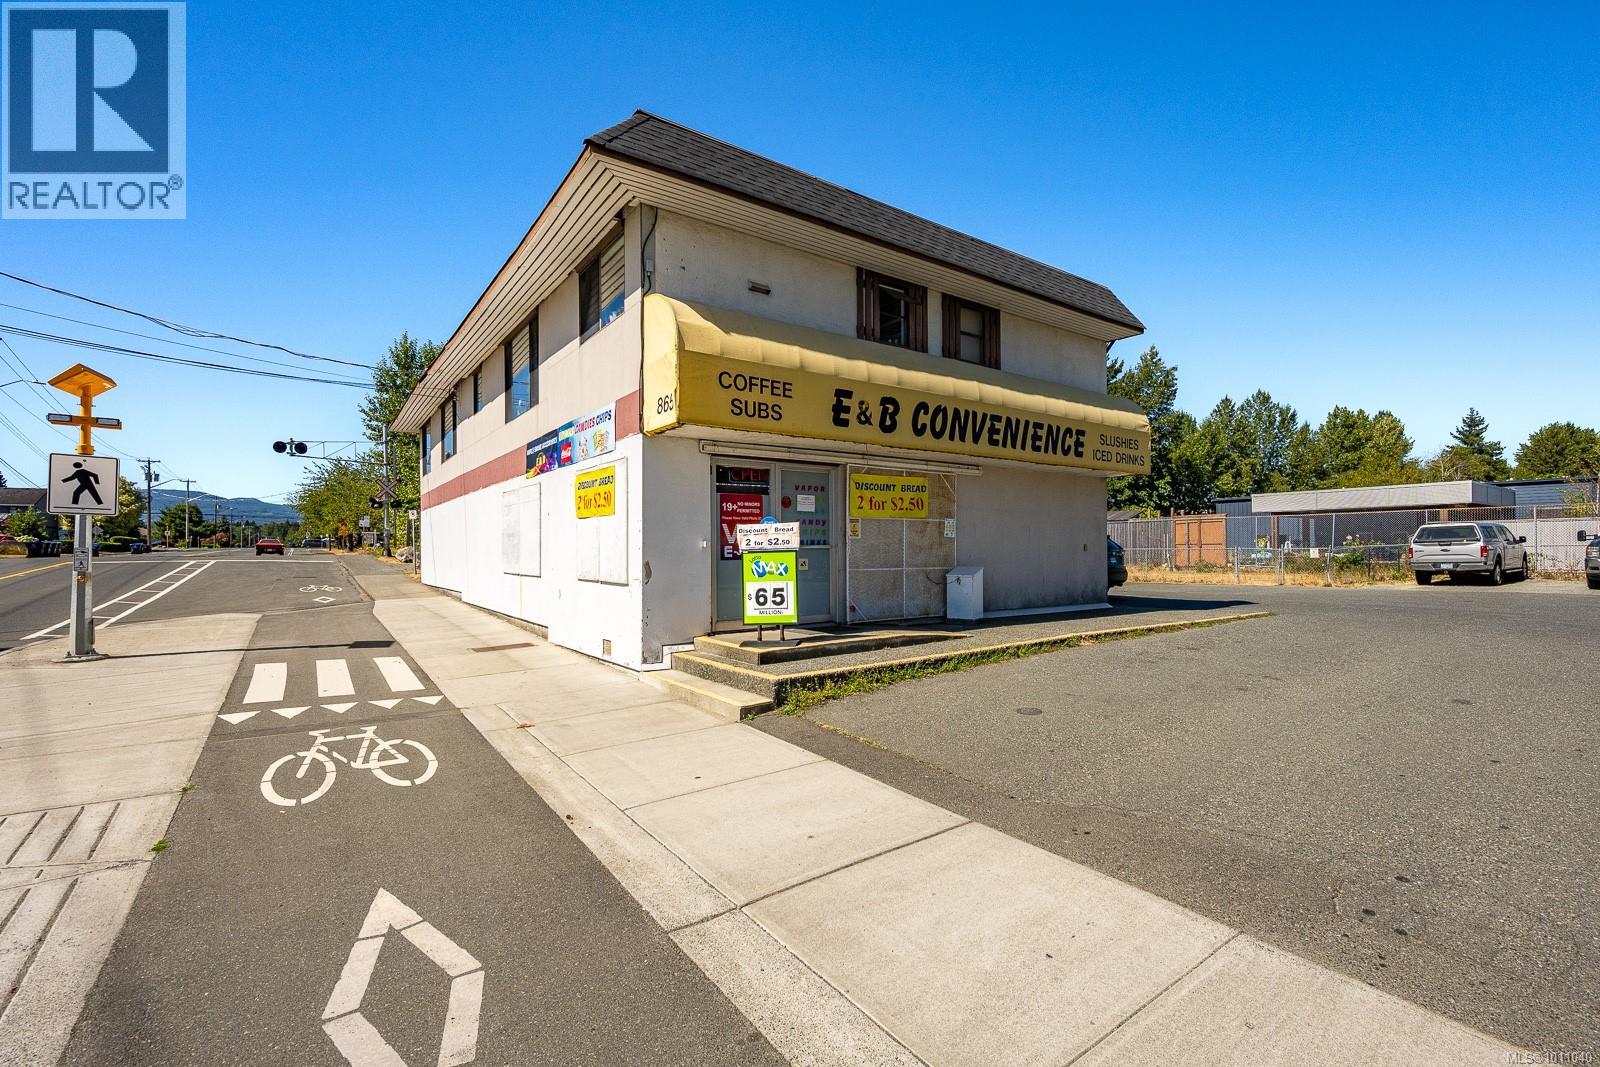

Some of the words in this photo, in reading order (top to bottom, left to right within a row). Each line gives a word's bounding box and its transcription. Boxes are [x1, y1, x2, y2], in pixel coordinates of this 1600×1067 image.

[718, 371, 793, 399] COFFEE
[596, 409, 612, 426] CHIPS
[730, 398, 783, 421] SUBS
[831, 388, 854, 428] E
[856, 400, 874, 426] &
[878, 396, 900, 434] B
[911, 400, 1086, 458] CONVENIENCE
[1099, 433, 1139, 450] SLUSHIES
[1092, 449, 1113, 462] ICED
[1115, 451, 1145, 467] DRINKS
[855, 481, 896, 492] DISCOUNT
[901, 484, 927, 493] BREAD
[577, 495, 582, 510] 2
[583, 494, 592, 510] for
[593, 490, 612, 509] $2.50
[722, 502, 738, 511] 19+
[857, 495, 864, 510] 2
[869, 496, 887, 511] for
[890, 496, 924, 511] $2.50
[800, 519, 827, 527] ANDY
[767, 537, 790, 546] $2.50
[752, 561, 787, 578] MAX
